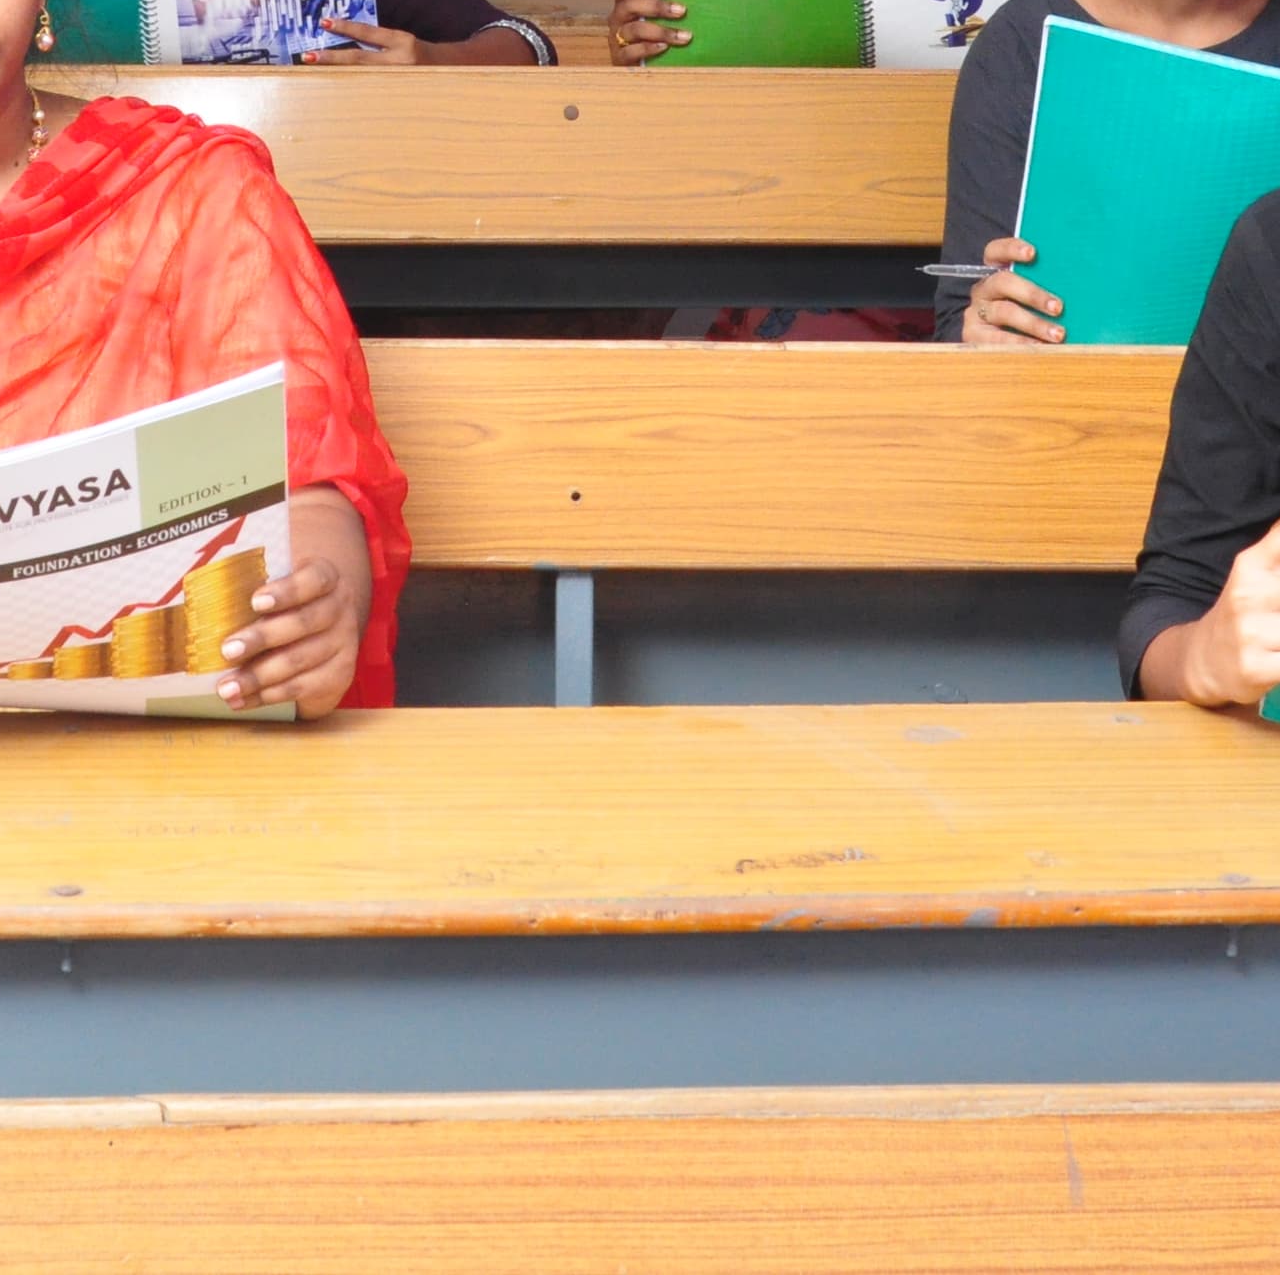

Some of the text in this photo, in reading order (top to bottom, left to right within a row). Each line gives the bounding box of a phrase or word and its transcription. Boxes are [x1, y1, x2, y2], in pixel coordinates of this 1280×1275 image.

[158, 482, 222, 514] EDITION
[12, 542, 122, 579] FOUNDATION
[136, 508, 230, 549] ECONOMICS
